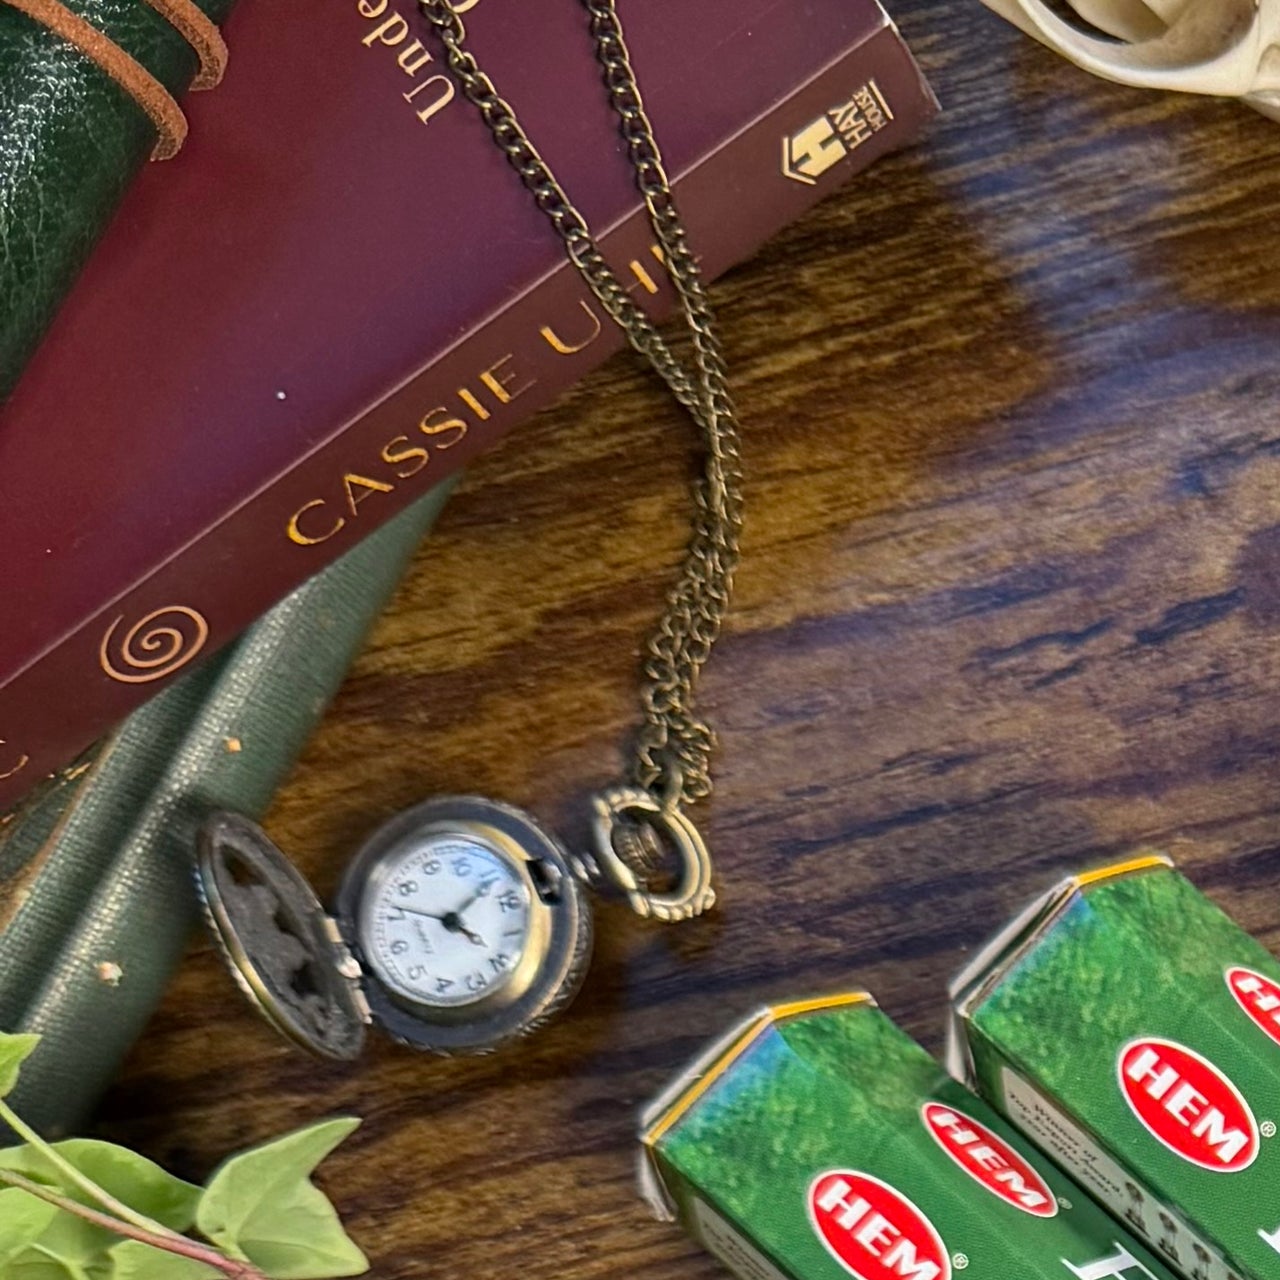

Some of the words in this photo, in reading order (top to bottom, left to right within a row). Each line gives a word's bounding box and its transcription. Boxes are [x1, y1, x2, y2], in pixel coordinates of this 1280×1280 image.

[827, 101, 873, 149] HAY
[286, 353, 538, 546] CASSIE
[928, 1106, 1049, 1208] HEM
[1126, 1047, 1249, 1164] HEM
